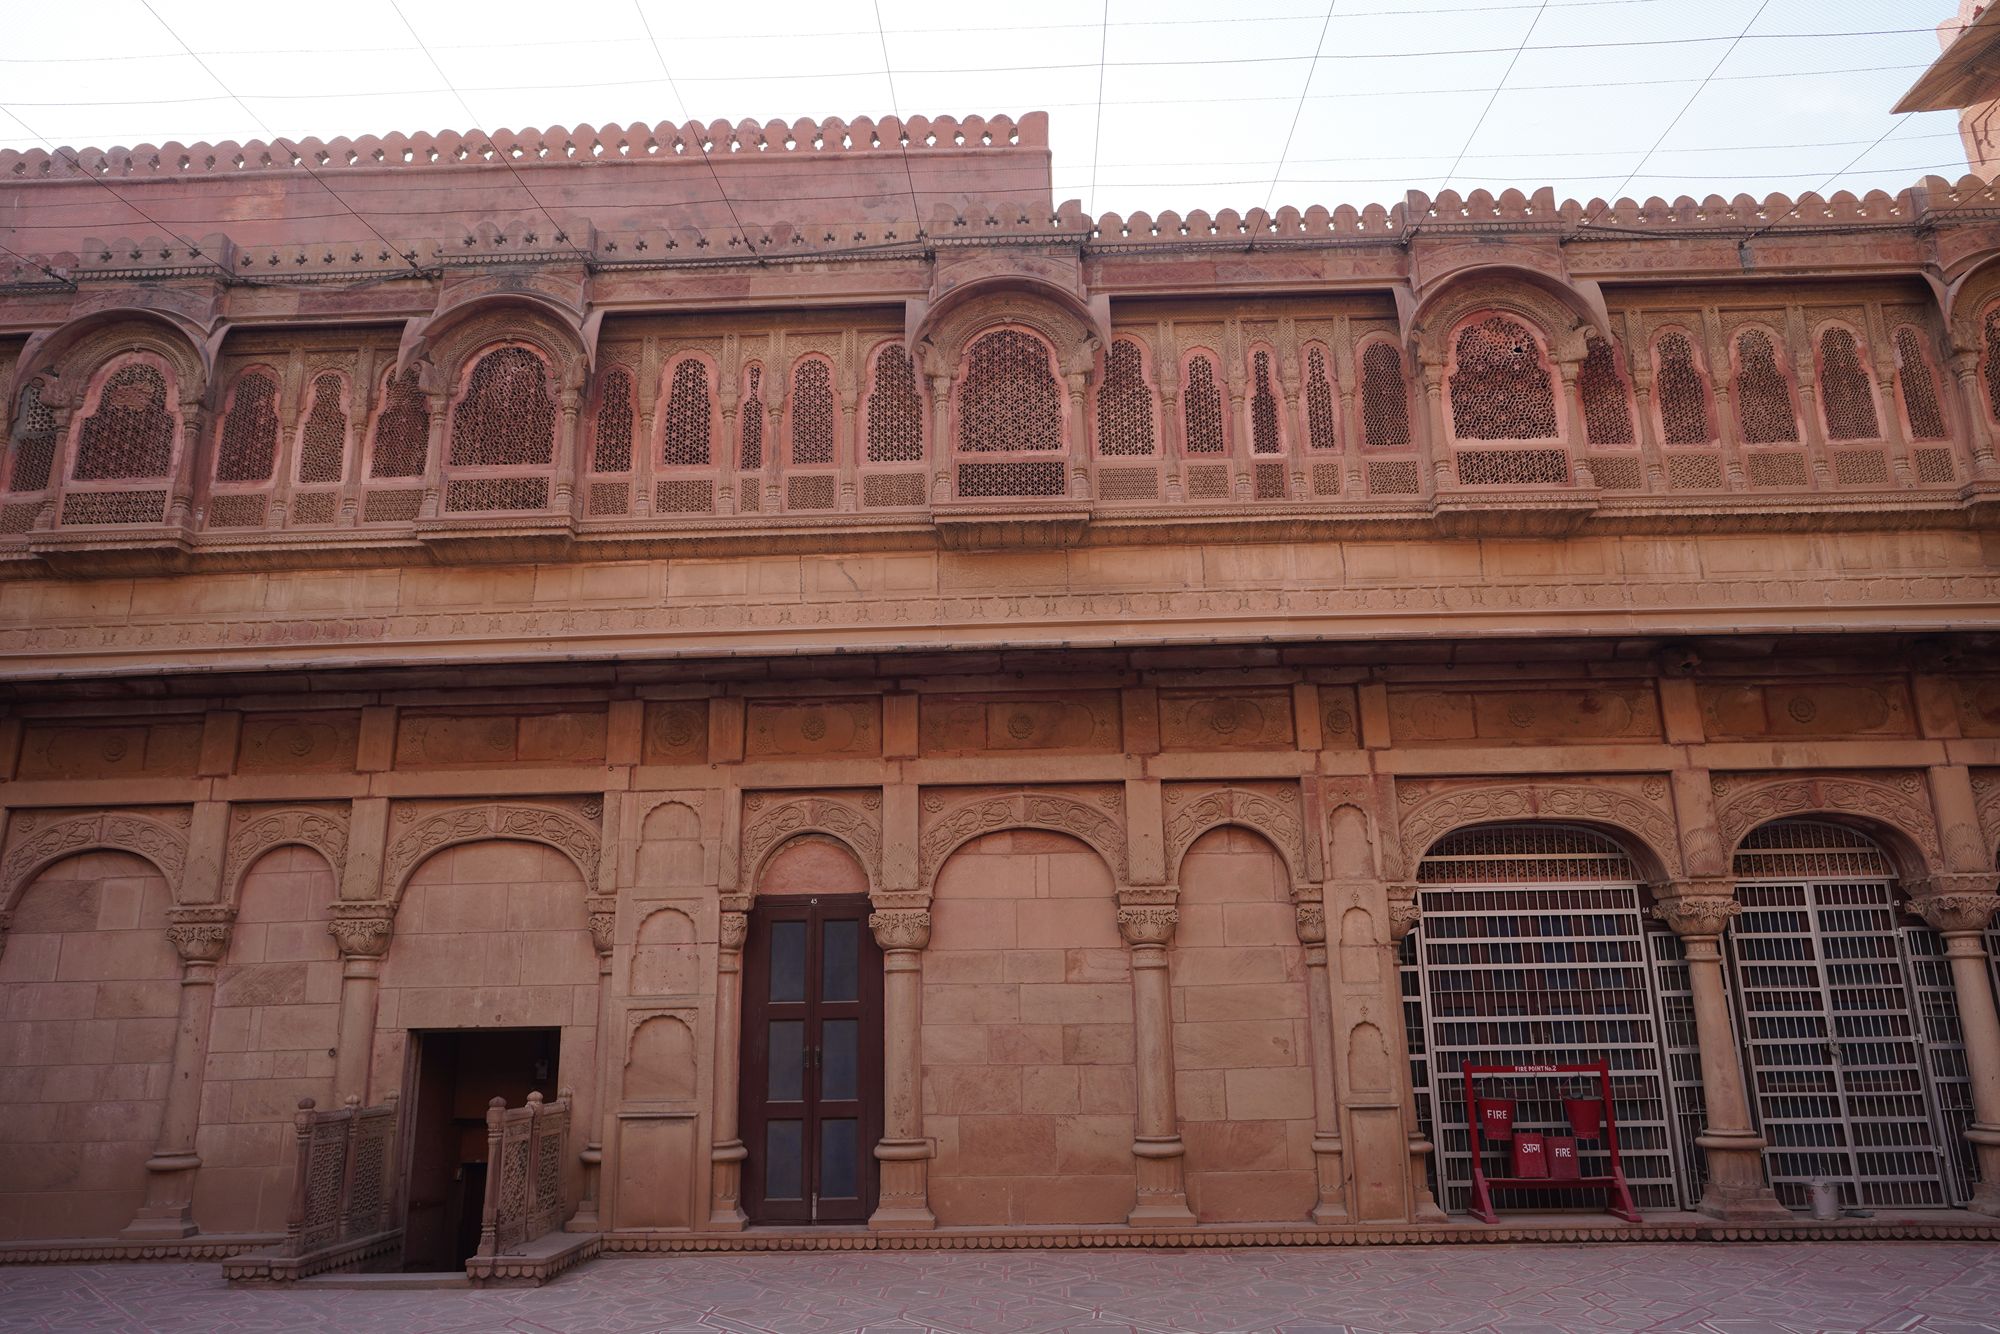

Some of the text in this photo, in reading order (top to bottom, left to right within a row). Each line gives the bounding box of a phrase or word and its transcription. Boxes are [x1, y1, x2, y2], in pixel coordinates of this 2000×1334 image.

[1487, 1110, 1507, 1119] FIRE
[1522, 1144, 1540, 1153] आग
[1555, 1148, 1571, 1157] FIRE
